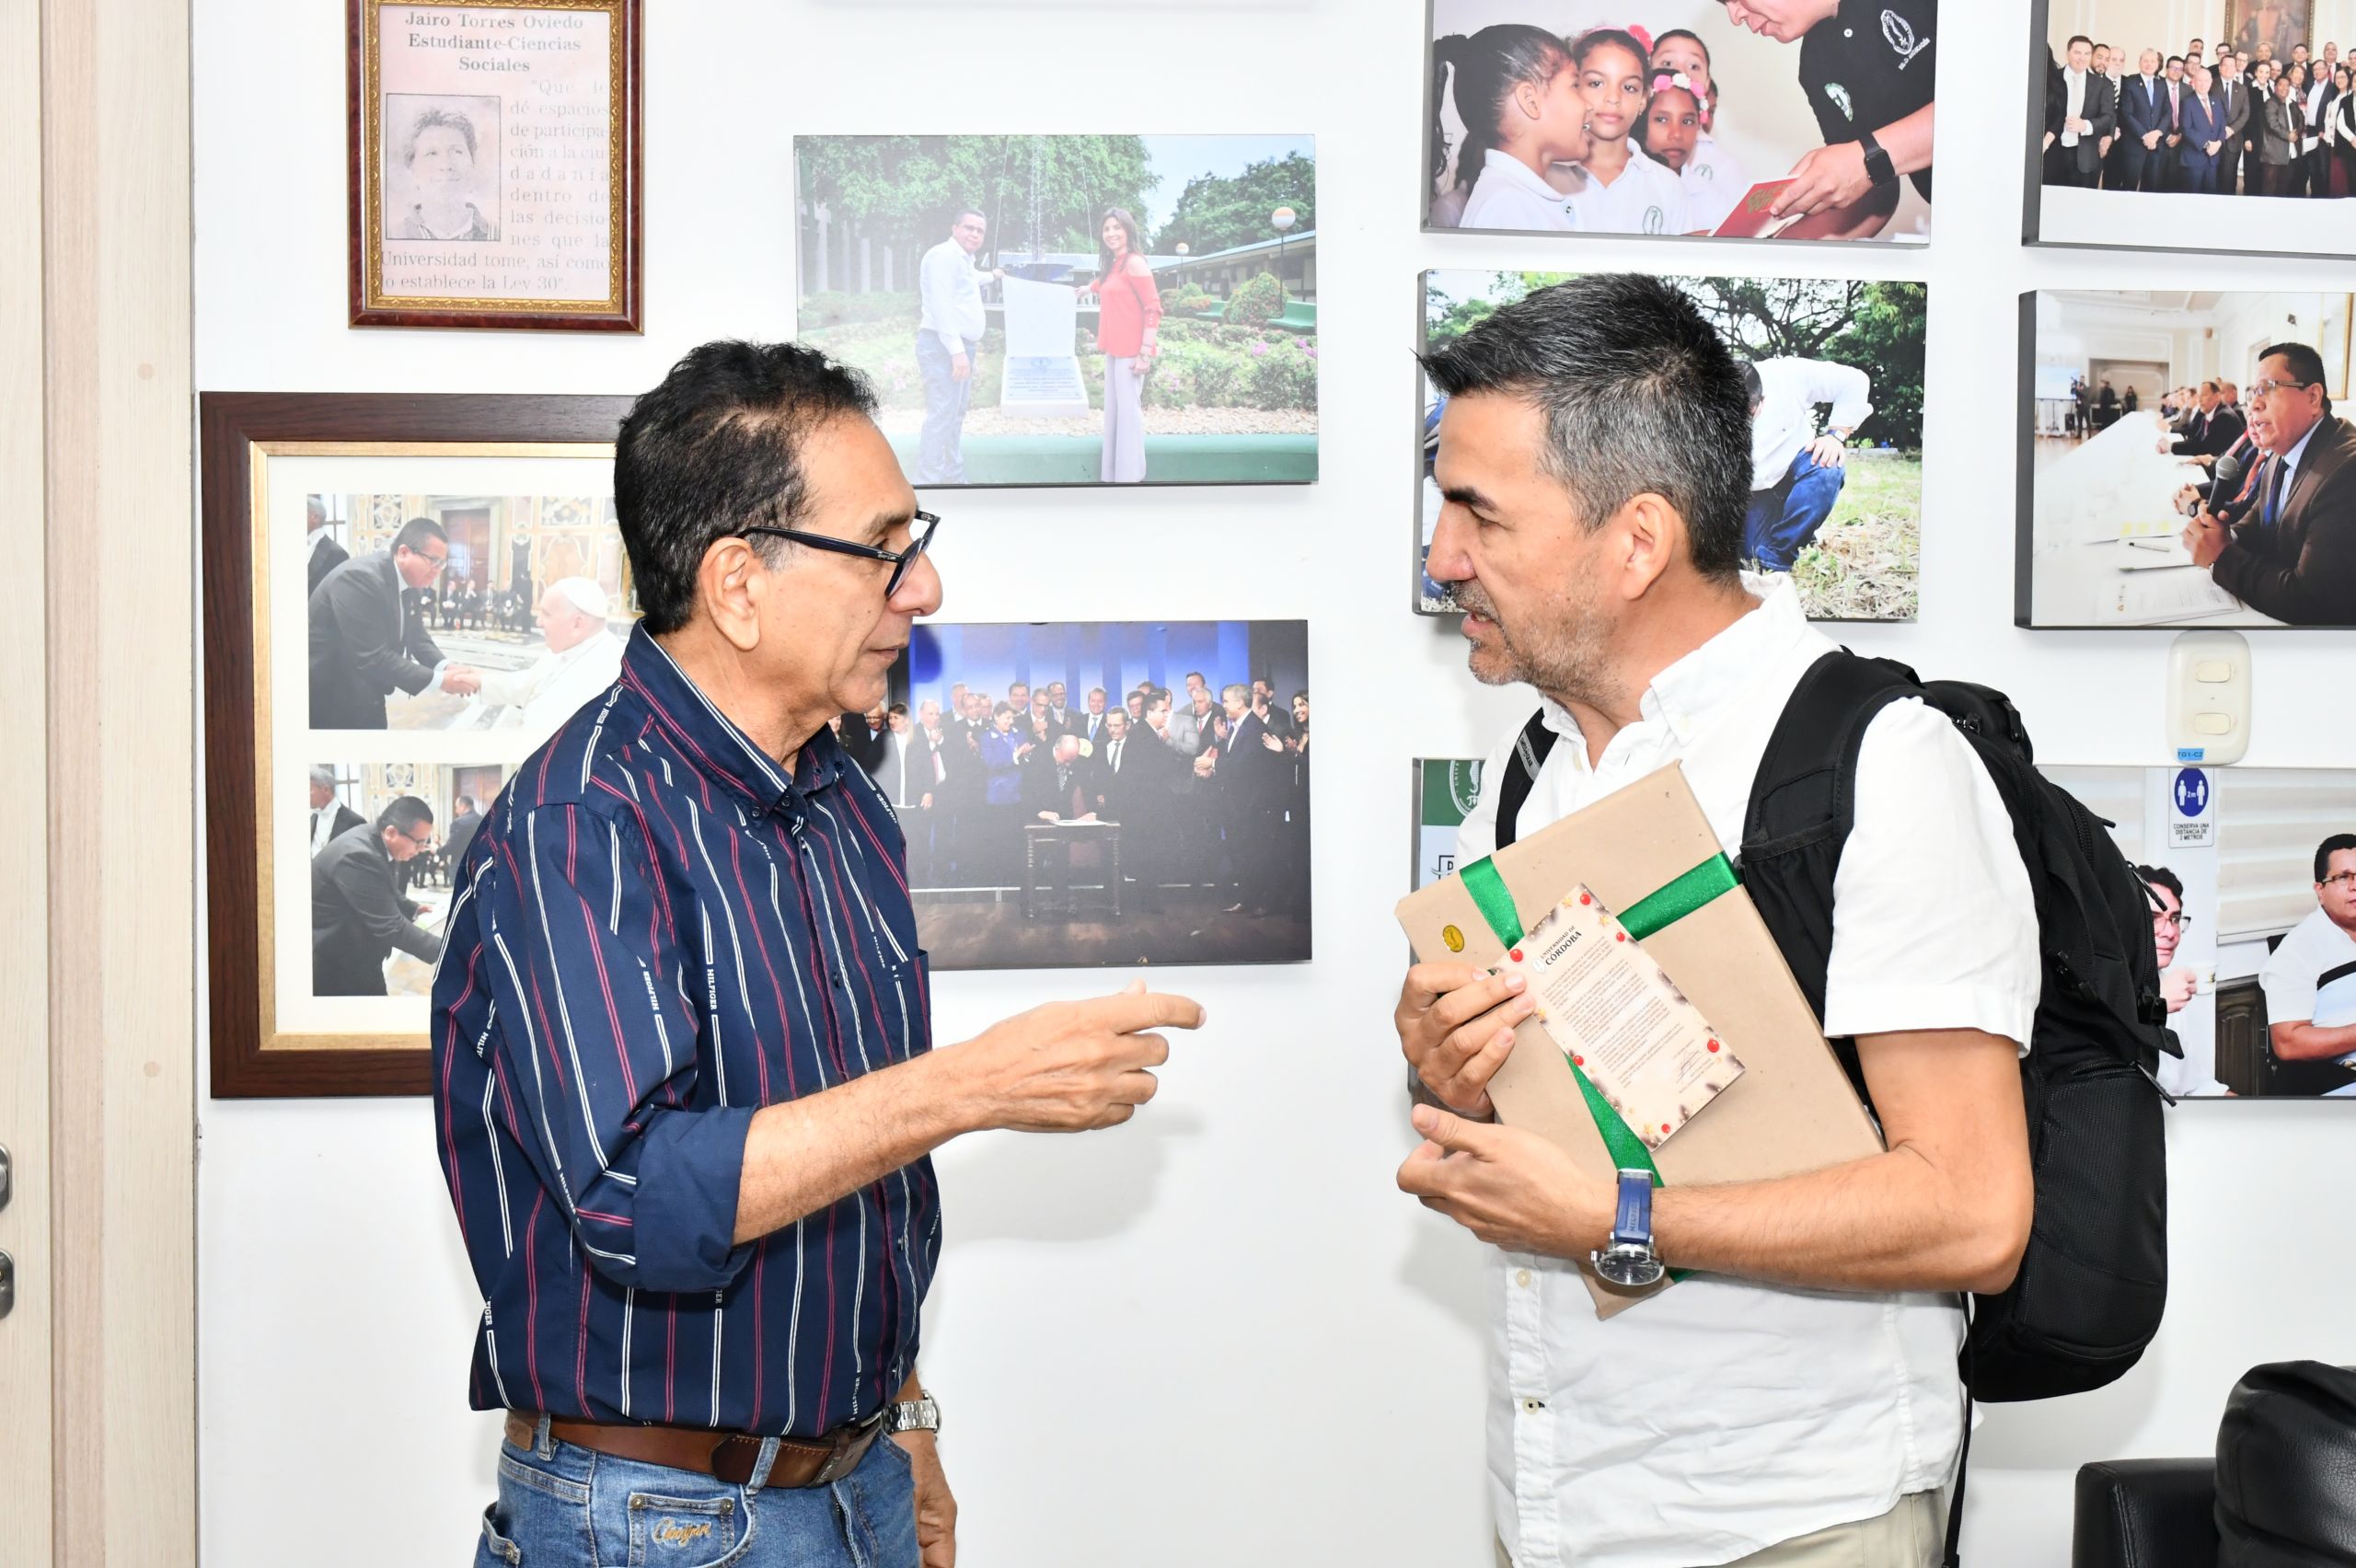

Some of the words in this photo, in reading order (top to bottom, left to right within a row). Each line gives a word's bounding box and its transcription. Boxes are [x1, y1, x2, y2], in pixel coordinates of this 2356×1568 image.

[405, 12, 450, 27] Jairo
[457, 14, 515, 29] Torres
[523, 15, 583, 29] Oviedo
[409, 33, 582, 52] Estudiante-Ciencias
[458, 56, 530, 72] Sociales
[510, 99, 530, 115] dé
[510, 121, 530, 137] de
[562, 144, 575, 158] la
[510, 187, 572, 202] dentro
[588, 190, 609, 203] de
[510, 210, 535, 224] las
[510, 235, 541, 247] nes
[551, 235, 583, 249] que
[595, 233, 609, 248] la
[381, 250, 478, 267] Universidad
[537, 254, 560, 269] así
[401, 274, 476, 289] establece
[482, 274, 496, 290] la
[502, 275, 531, 291] Ley
[707, 968, 718, 1010] HILFIGER
